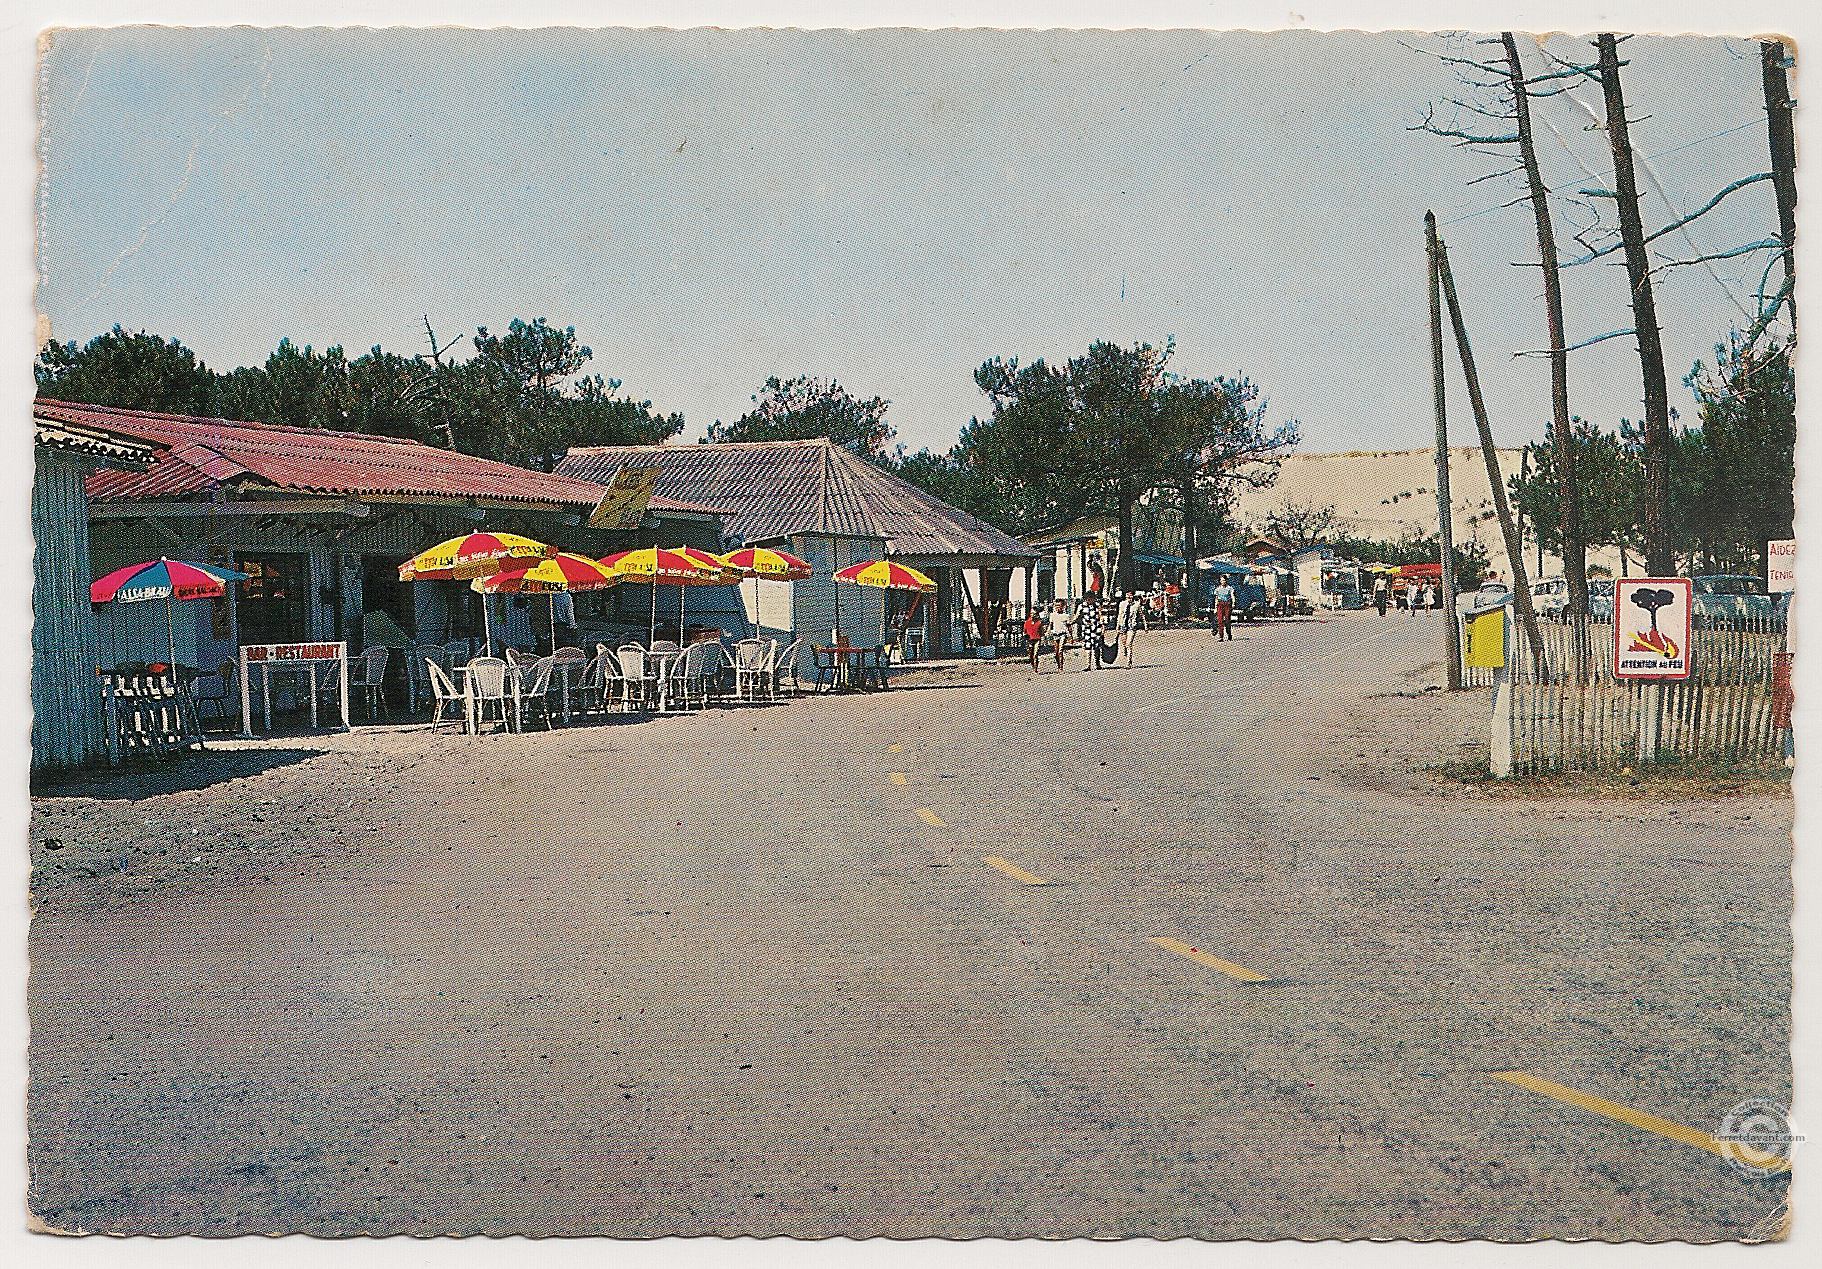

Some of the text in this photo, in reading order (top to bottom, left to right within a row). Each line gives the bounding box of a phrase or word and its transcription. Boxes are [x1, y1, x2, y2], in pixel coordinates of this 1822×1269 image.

[247, 646, 268, 661] BAR
[276, 643, 341, 660] RESTAURANT
[1620, 659, 1684, 669] ATTENTION AU FEU
